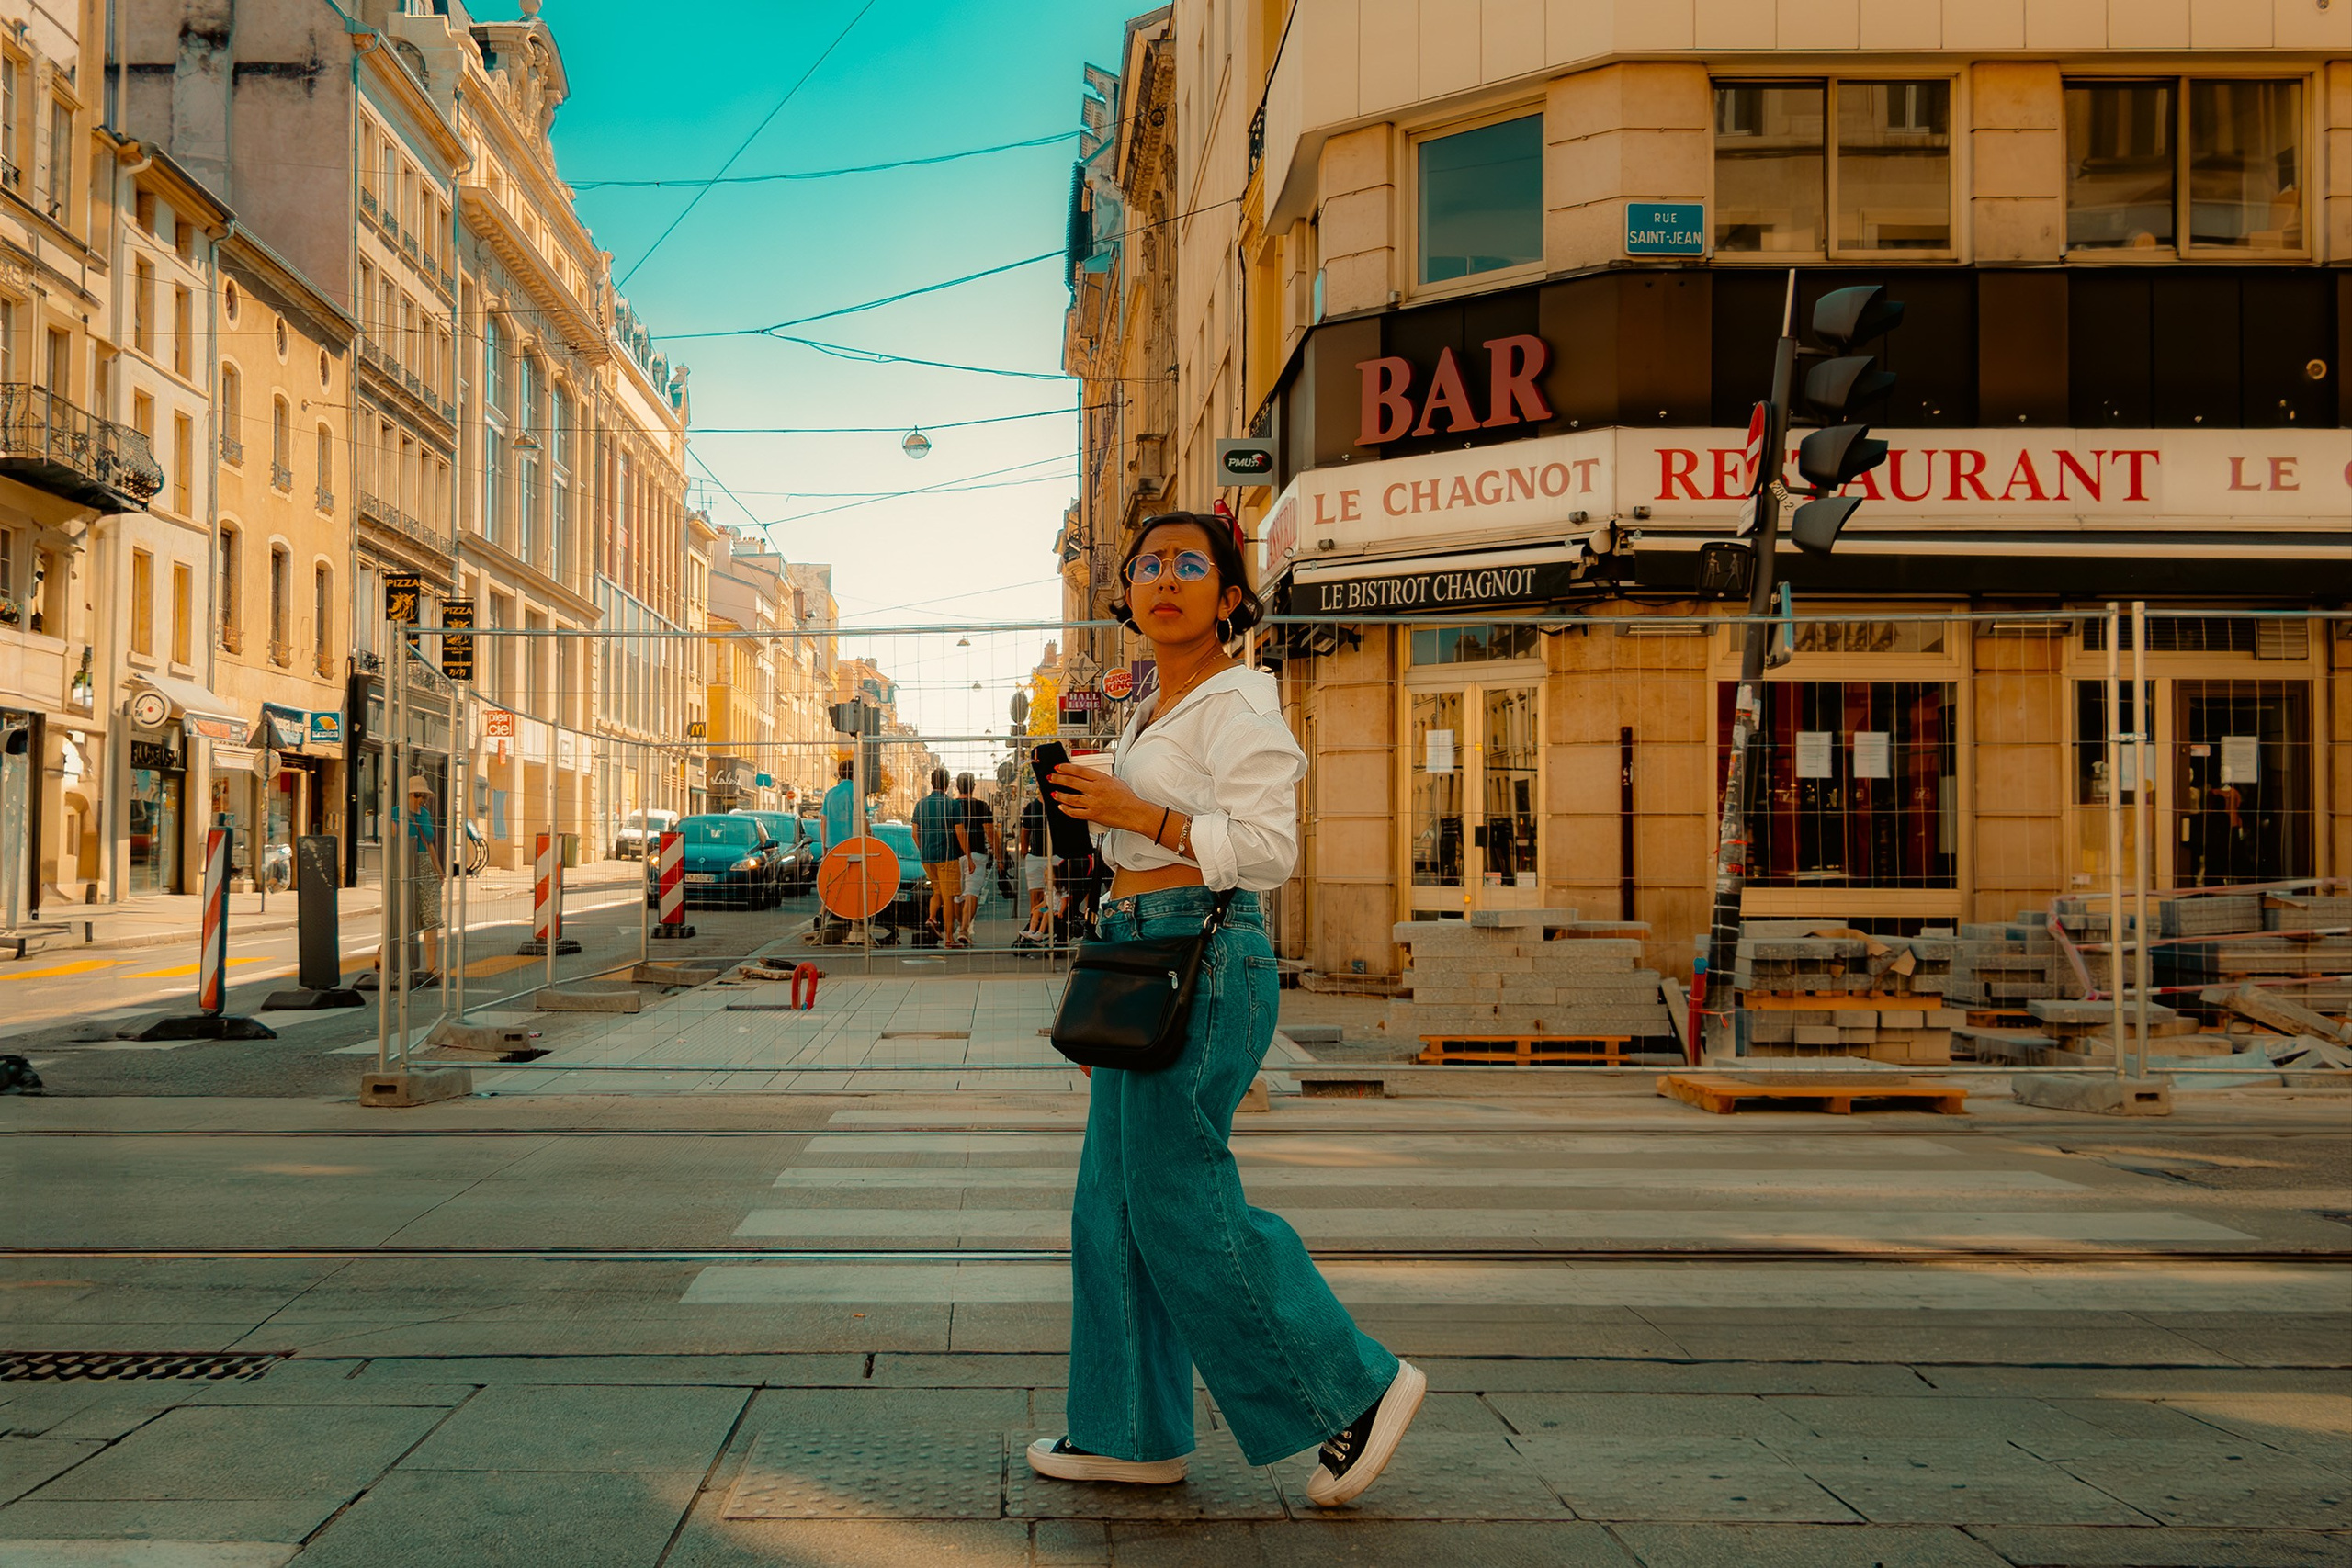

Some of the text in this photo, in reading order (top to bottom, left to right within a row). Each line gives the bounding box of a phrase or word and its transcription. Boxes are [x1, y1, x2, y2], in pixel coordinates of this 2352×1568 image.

[1654, 213, 1677, 223] RUE
[1630, 231, 1702, 244] SAINT-JEAN
[1354, 334, 1553, 446] BAR
[1228, 458, 1251, 467] PMU
[2227, 457, 2300, 491] LE
[1314, 458, 1600, 525] LE CHAGNOT
[386, 579, 420, 587] PIZZA
[1320, 568, 1536, 611] LE BISTROT CHAGNOT
[443, 606, 473, 615] PIZZA
[1103, 672, 1132, 683] BURGER
[1104, 679, 1132, 694] KING
[488, 712, 513, 723] plein
[488, 722, 513, 736] ciel
